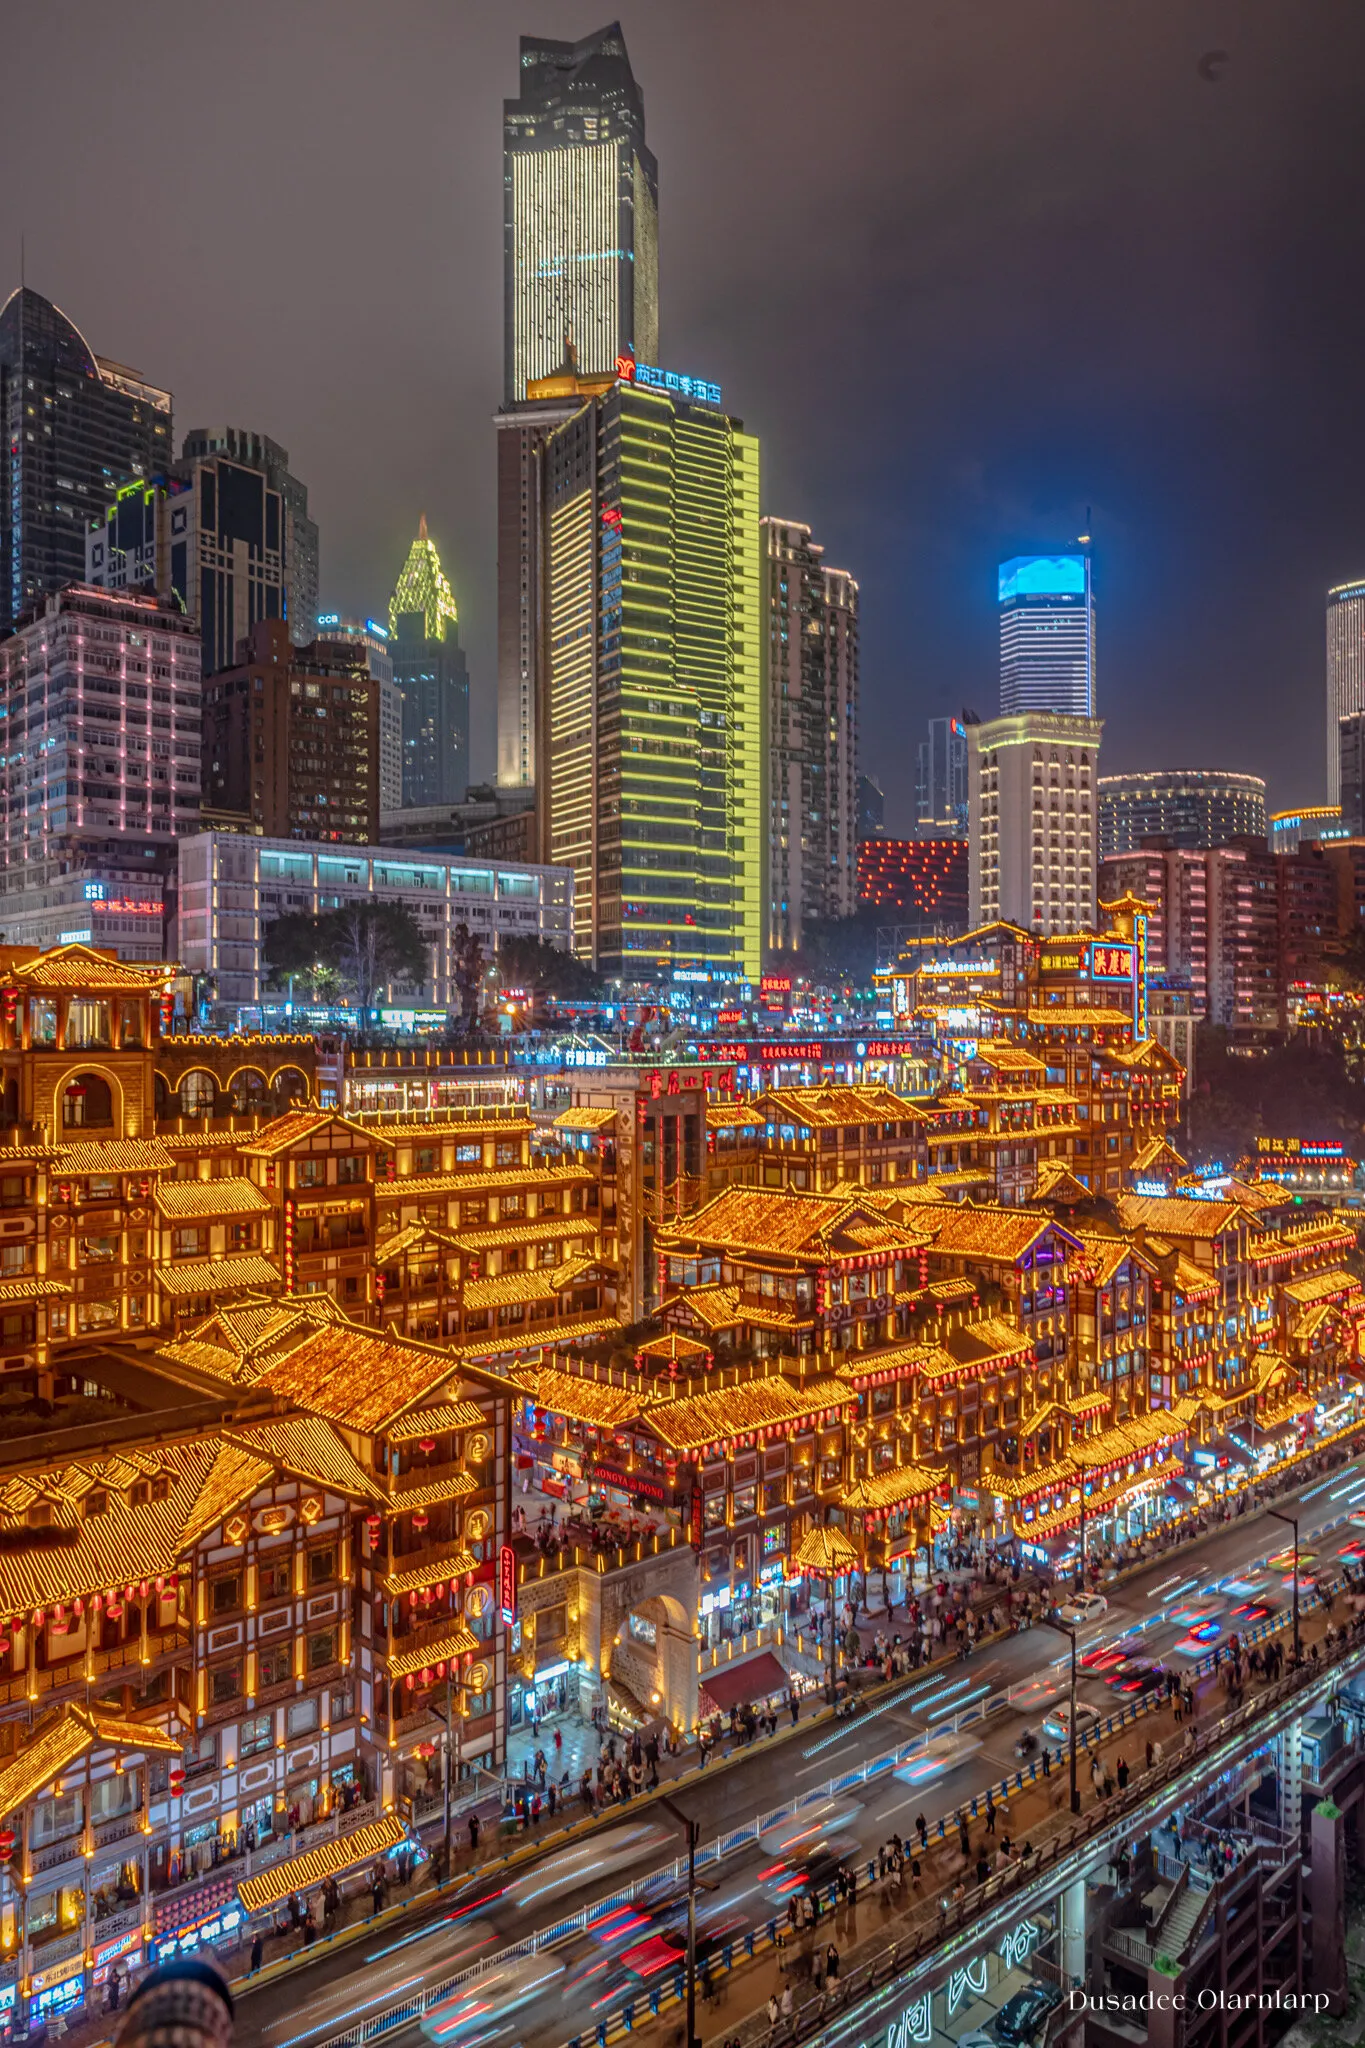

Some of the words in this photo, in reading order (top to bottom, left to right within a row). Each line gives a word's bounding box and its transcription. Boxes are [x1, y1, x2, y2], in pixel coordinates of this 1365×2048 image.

[636, 363, 721, 404] 两江四季酒店
[318, 614, 338, 625] CCB
[1094, 948, 1131, 975] 洪崖洞
